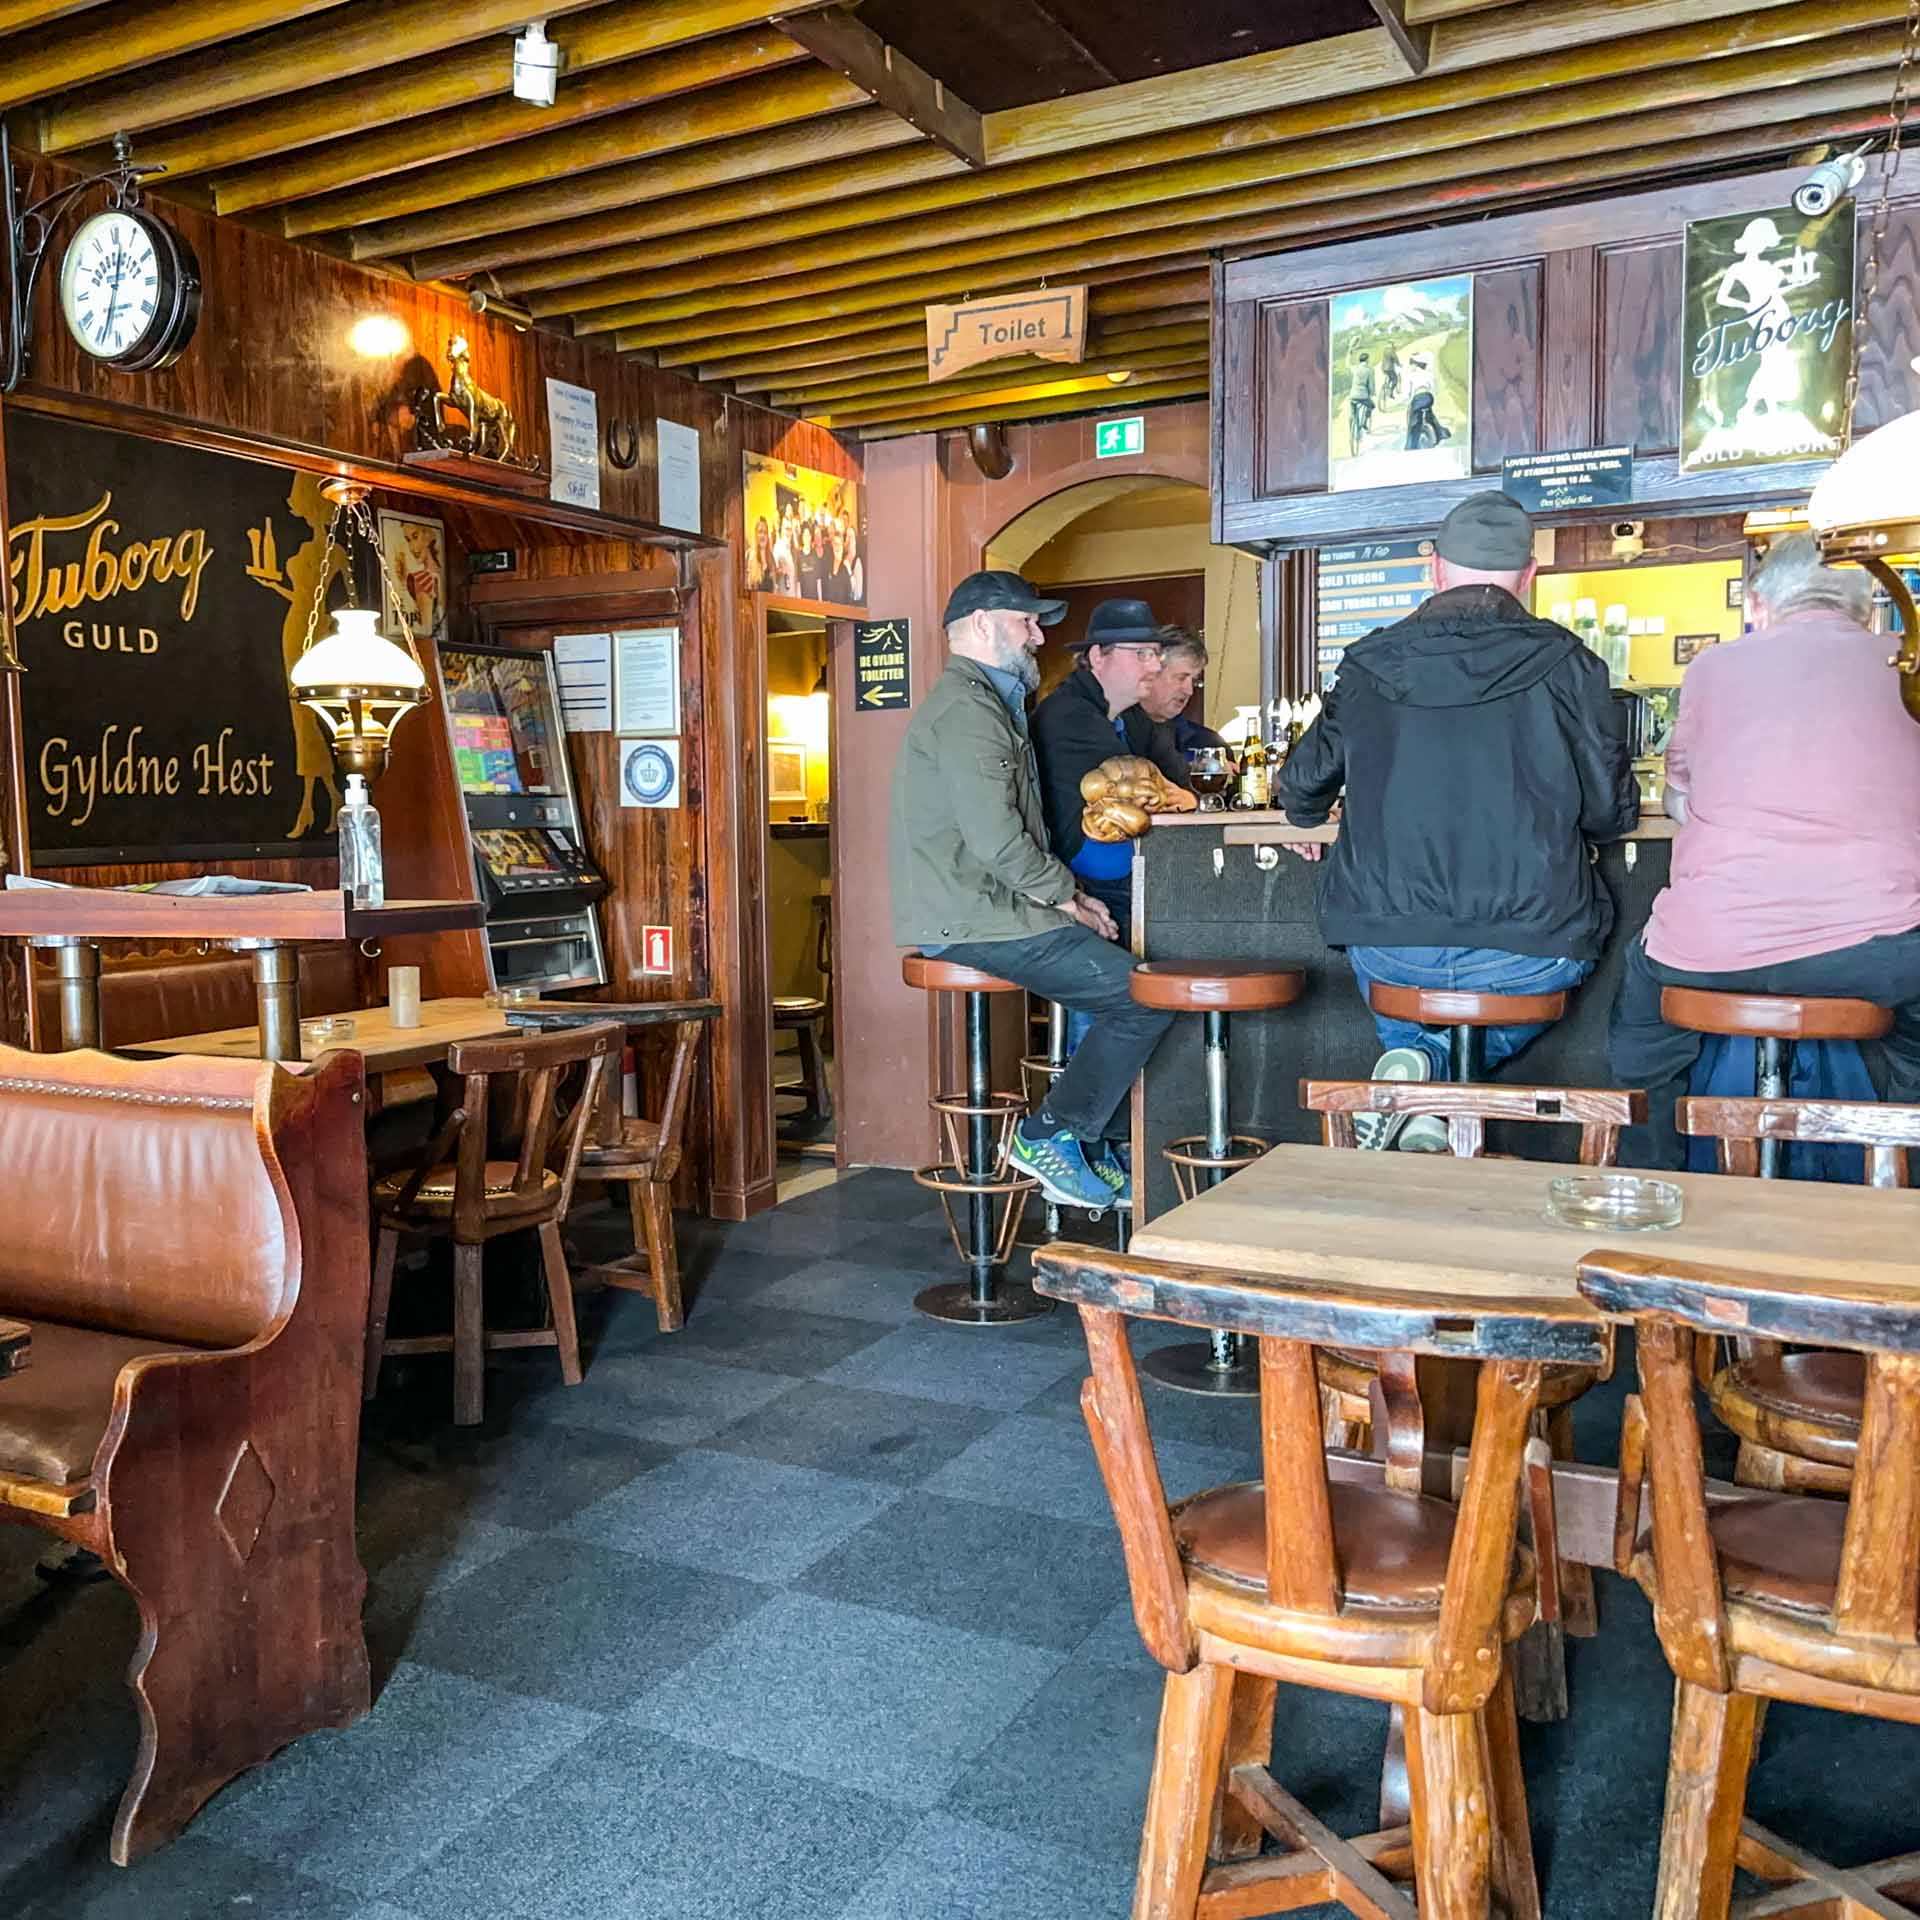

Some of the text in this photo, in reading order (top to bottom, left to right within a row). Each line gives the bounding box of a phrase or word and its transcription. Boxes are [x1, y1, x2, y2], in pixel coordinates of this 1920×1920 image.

[978, 317, 1046, 345] Toilet
[1692, 295, 1850, 379] Tuborg
[9, 489, 214, 627] Tuborg
[1346, 571, 1385, 585] TUBORG
[63, 621, 160, 654] GULD
[861, 668, 905, 682] TOILETTER
[40, 724, 274, 827] Gyldne Hest
